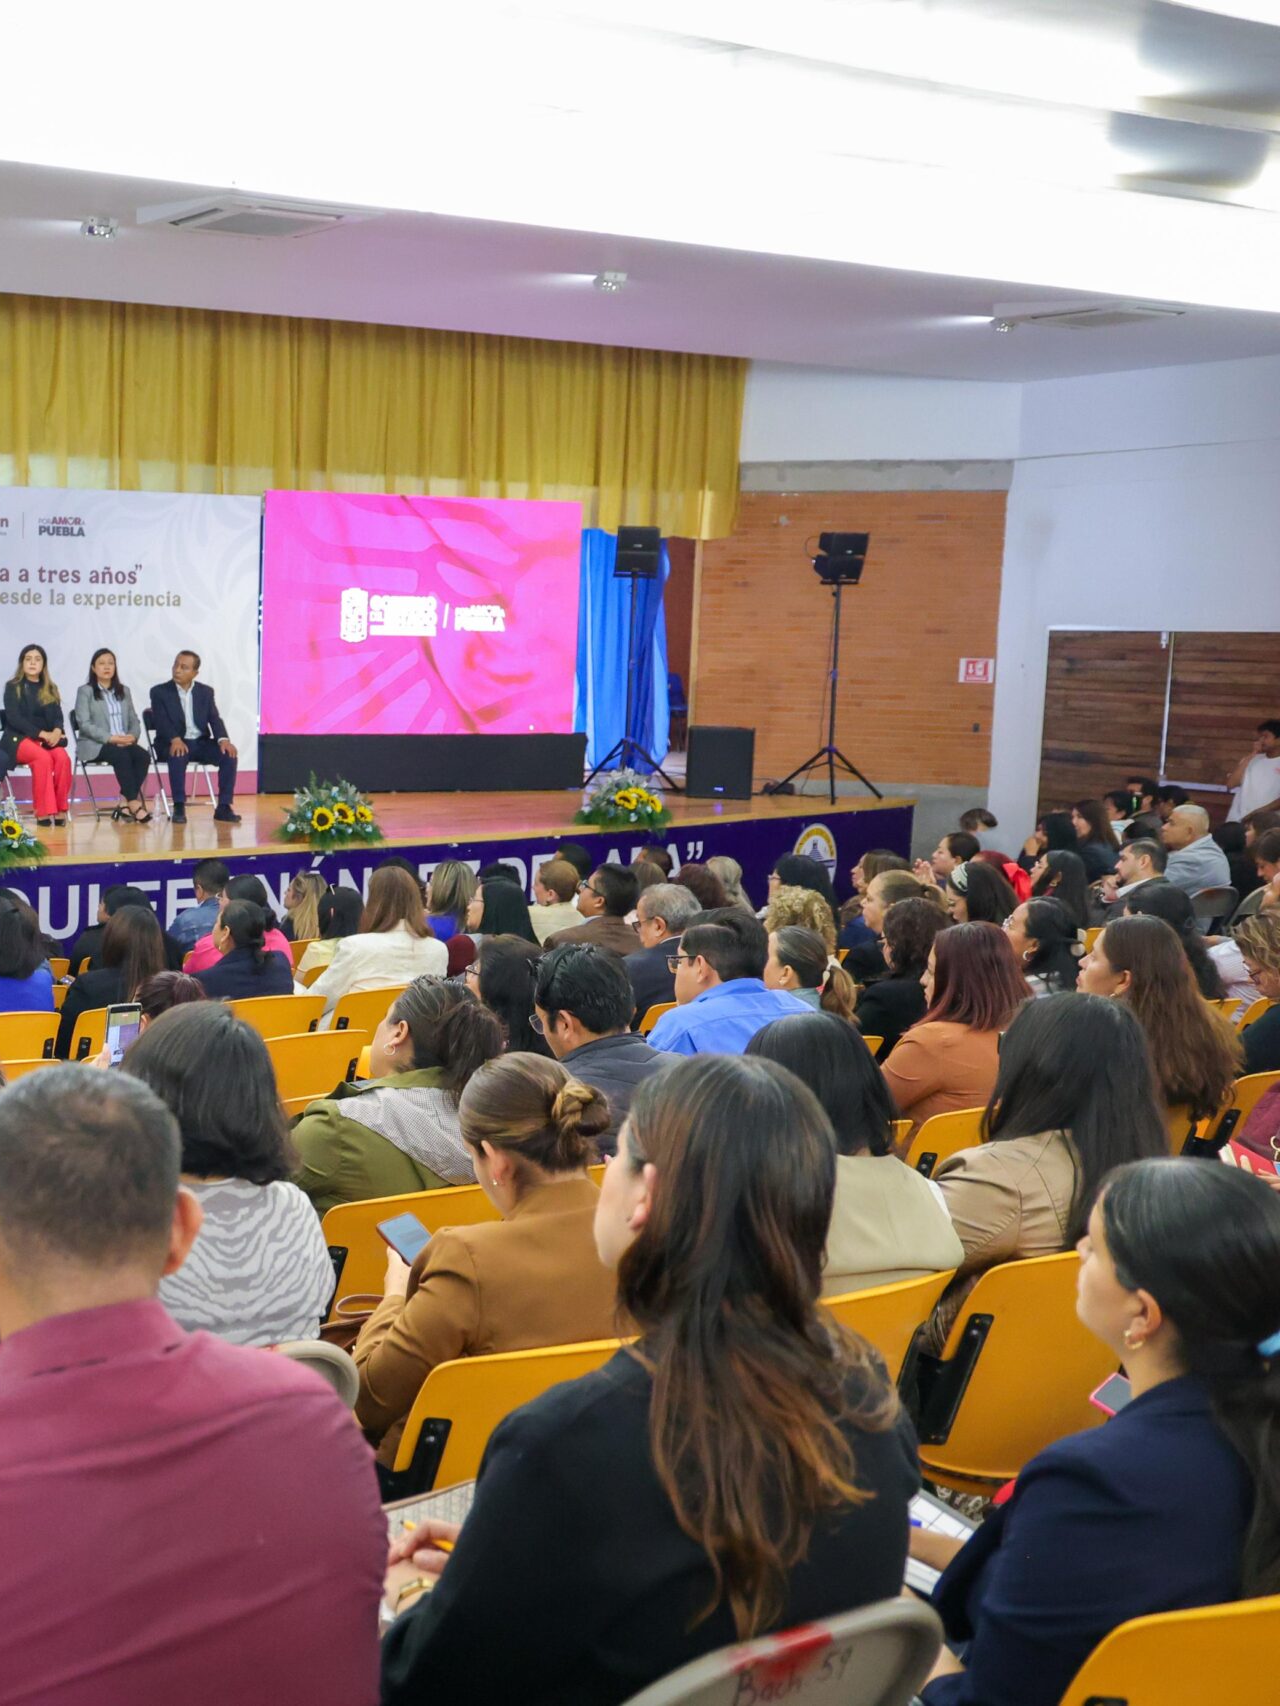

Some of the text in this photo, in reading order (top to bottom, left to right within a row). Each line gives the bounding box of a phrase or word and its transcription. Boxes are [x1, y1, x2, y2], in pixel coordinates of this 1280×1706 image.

[51, 516, 81, 526] AMOR
[38, 525, 85, 537] PUEBLA
[18, 567, 29, 583] a
[38, 565, 81, 584] tres
[88, 564, 142, 585] años”
[49, 588, 66, 606] la
[73, 590, 181, 609] experiencia
